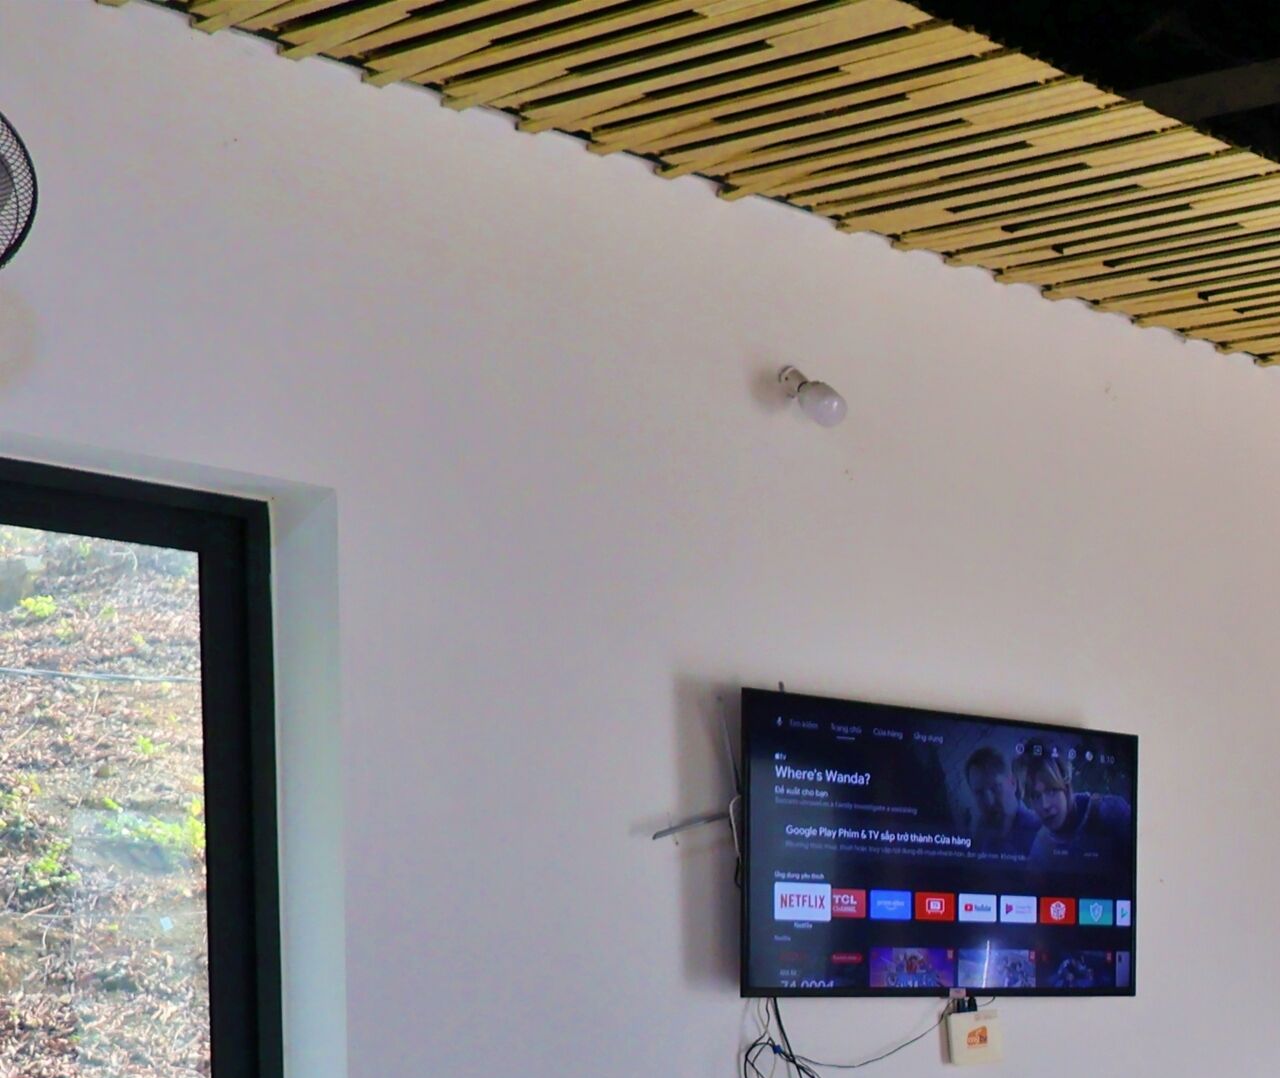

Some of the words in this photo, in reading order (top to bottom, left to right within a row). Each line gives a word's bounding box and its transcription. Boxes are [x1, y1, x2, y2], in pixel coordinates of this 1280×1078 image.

[774, 764, 823, 781] Where's
[825, 769, 871, 786] Wanda?
[785, 824, 817, 838] Google
[819, 826, 836, 839] Play
[838, 827, 859, 839] Phim
[860, 830, 867, 840] &
[868, 830, 880, 840] TV
[951, 835, 972, 848] hàng
[779, 893, 826, 910] NETFLIX
[832, 894, 857, 904] TCL
